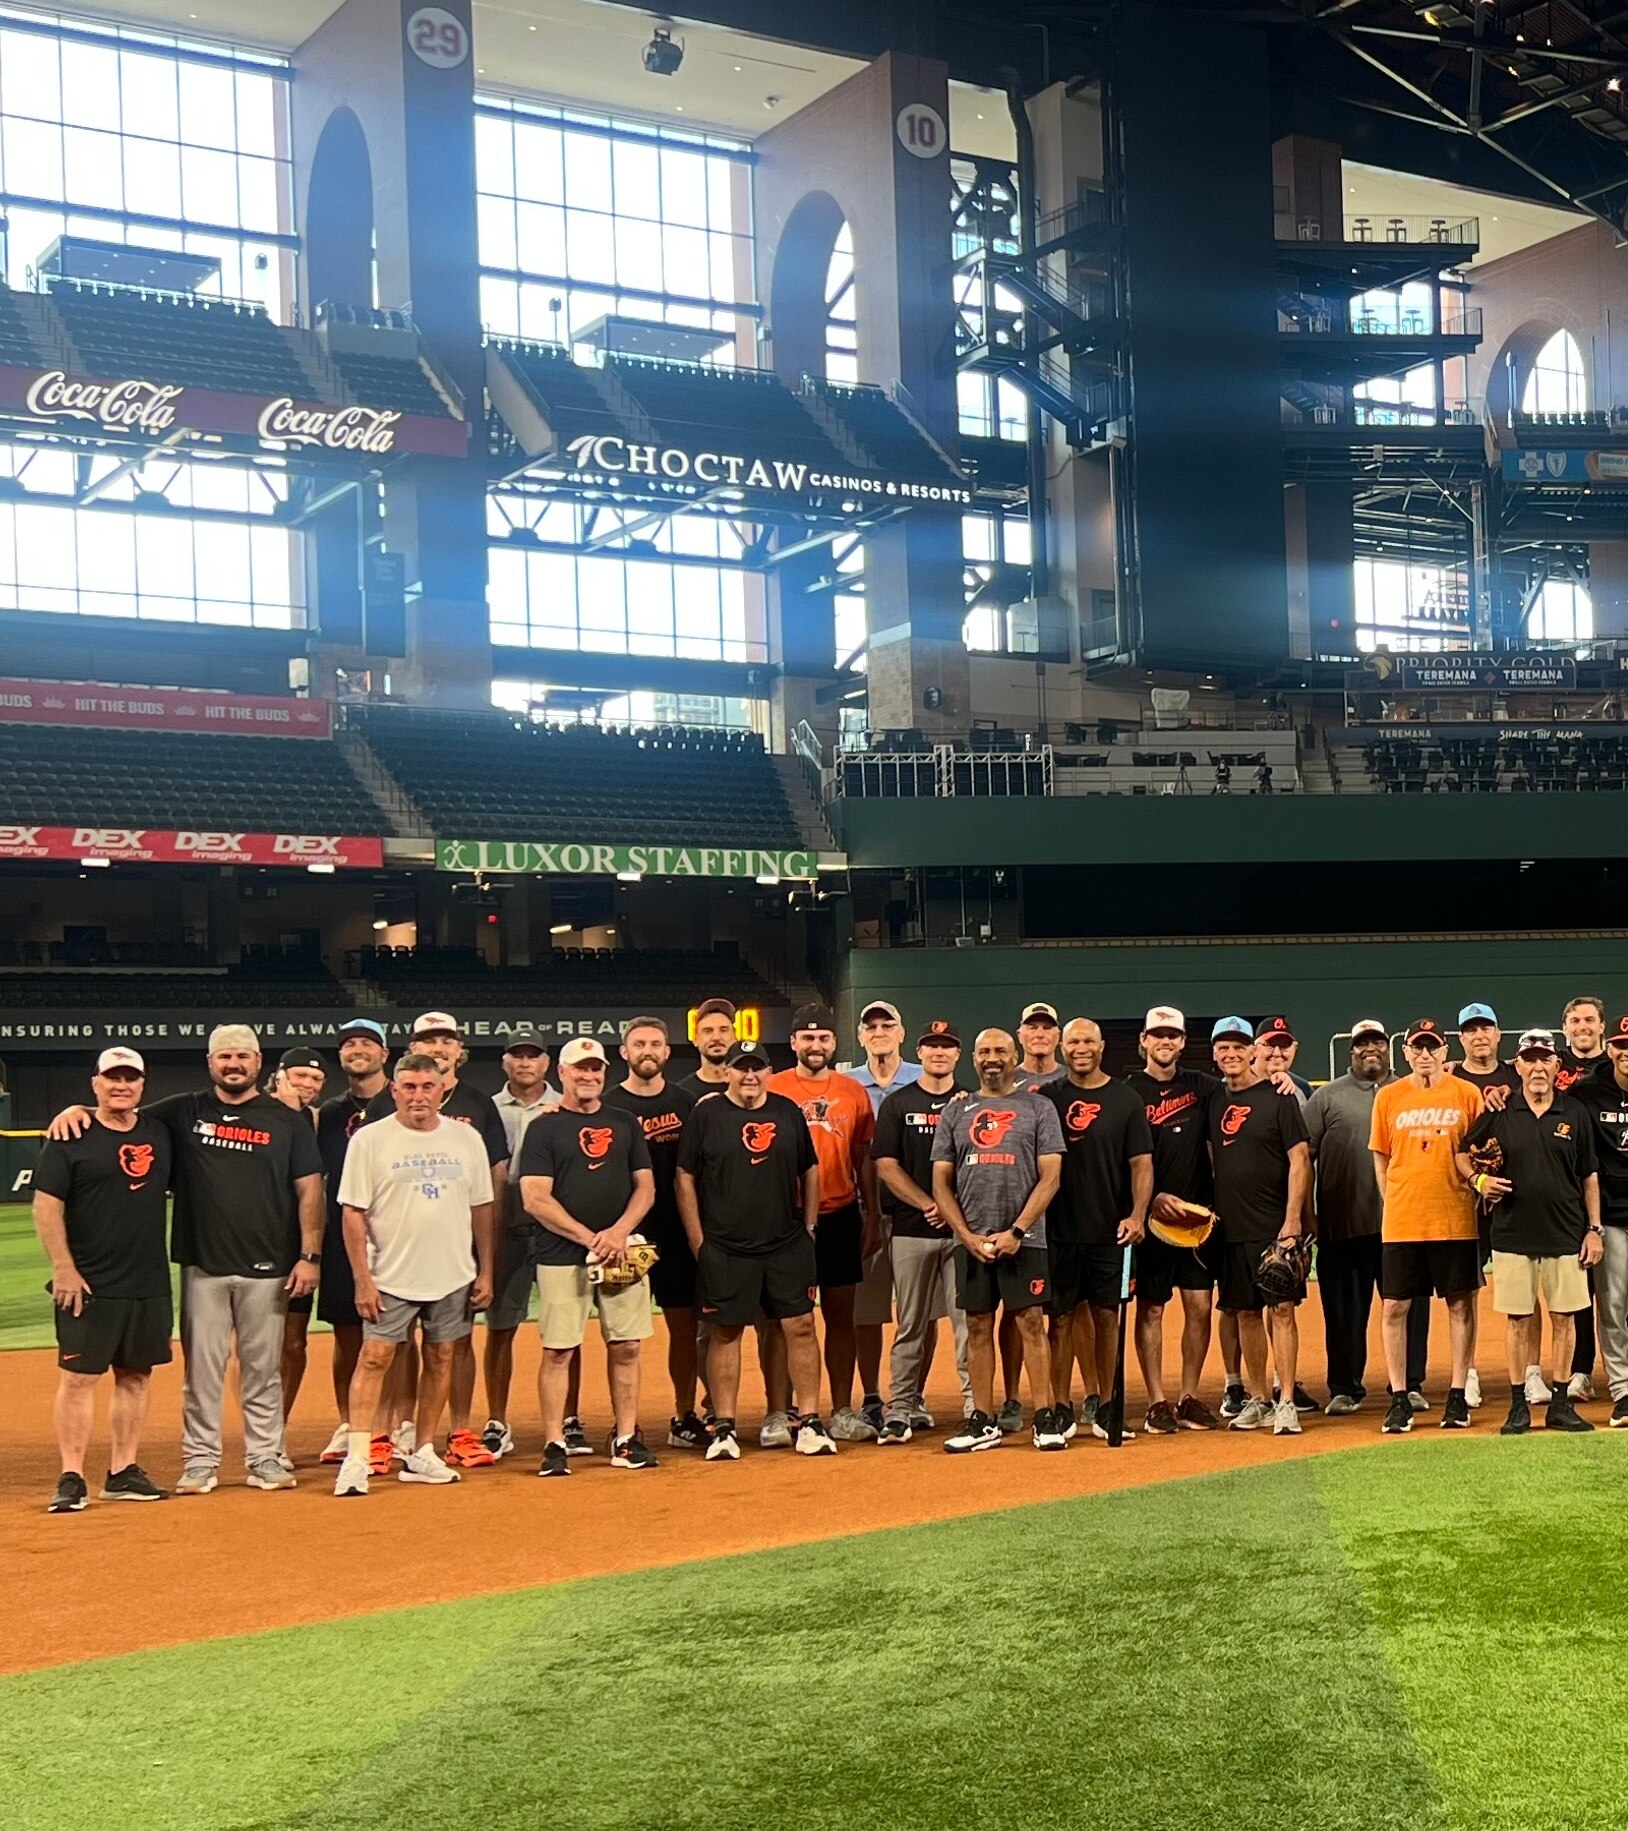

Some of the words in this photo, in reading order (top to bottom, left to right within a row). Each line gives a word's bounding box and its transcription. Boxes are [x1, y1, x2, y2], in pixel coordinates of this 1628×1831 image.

[416, 19, 460, 56] 29
[905, 115, 936, 146] 10
[27, 371, 184, 430] Coca-Cola
[258, 398, 401, 454] Coca-Cola
[593, 436, 807, 491] CHOCTAW
[809, 473, 881, 493] CASINOS
[885, 482, 896, 495] &
[901, 483, 971, 503] RESORTS
[1416, 670, 1477, 680] TEREMANA
[1502, 669, 1564, 680] TEREMANA
[74, 698, 97, 712] HIT
[100, 699, 126, 713] THE
[129, 702, 165, 716] BUDS
[205, 705, 227, 719] HIT
[229, 706, 253, 720] THE
[255, 708, 290, 722] BUDS
[1378, 728, 1431, 739] TEREMANA
[1499, 729, 1528, 741] SHARE
[71, 828, 146, 848] DEX
[175, 831, 246, 852] DEX
[273, 835, 342, 854] DEX
[90, 847, 153, 860] imaging
[191, 849, 253, 862] imaging
[289, 853, 348, 865] imaging
[477, 841, 618, 874] LUXOR
[628, 846, 809, 878] STAFFING
[104, 1024, 168, 1037] THOSE
[178, 1024, 205, 1036] WE
[285, 1023, 343, 1035] ALWA
[383, 1023, 412, 1034] TAY
[457, 1021, 534, 1035] HEAD
[557, 1020, 630, 1035] REA
[1395, 1108, 1460, 1130] ORIOLES
[217, 1125, 271, 1145] ORIOLES
[392, 1158, 461, 1170] BASEBALL
